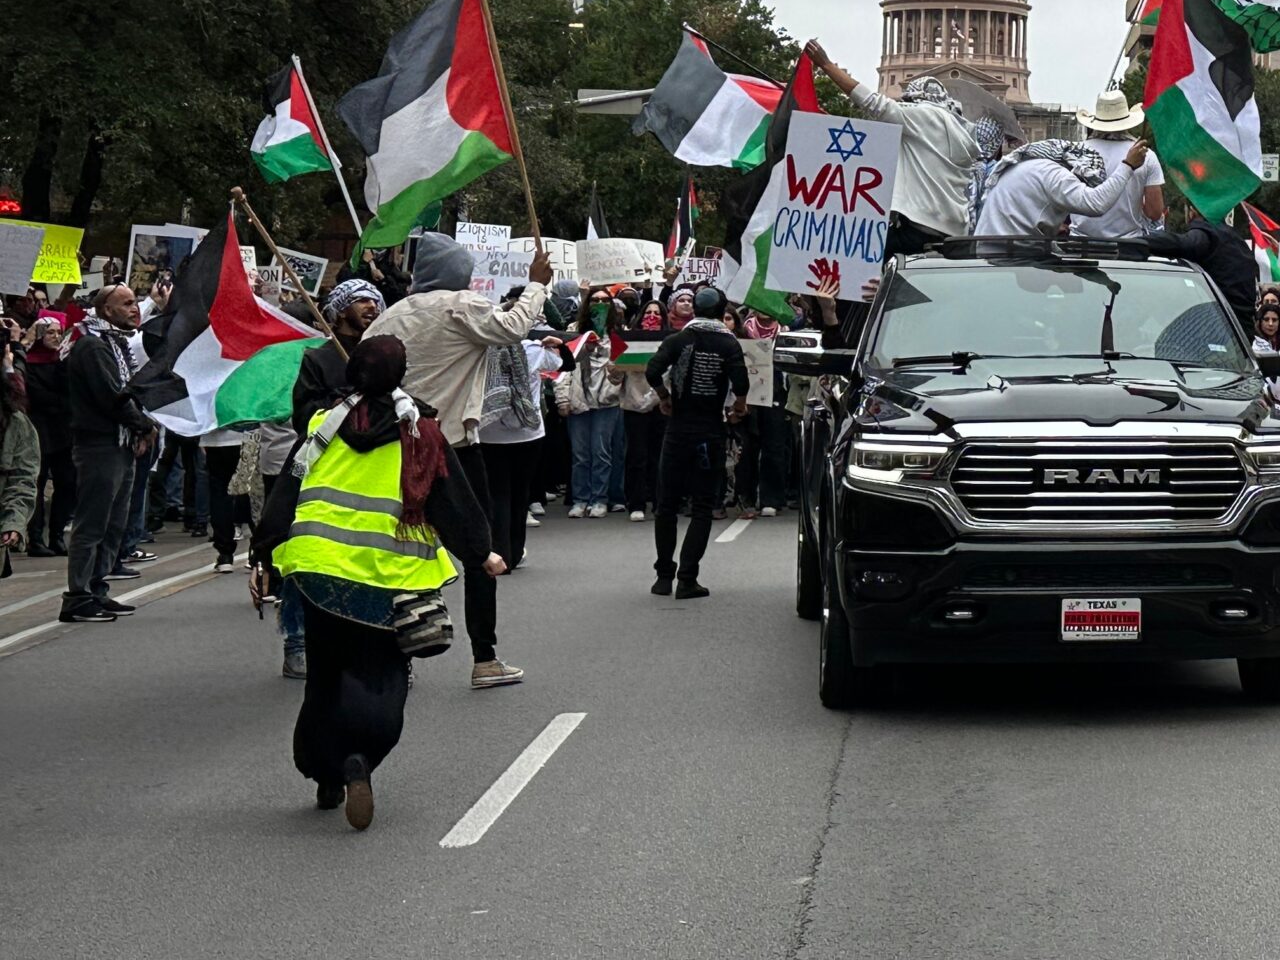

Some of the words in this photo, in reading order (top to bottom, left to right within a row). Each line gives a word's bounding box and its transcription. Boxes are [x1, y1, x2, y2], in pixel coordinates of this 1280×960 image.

[787, 154, 886, 216] WAR
[457, 223, 508, 238] ZIONISM
[773, 207, 887, 263] CRIMINALS
[477, 235, 487, 244] IS
[40, 270, 76, 282] GAZA
[487, 260, 530, 278] CAUS
[1043, 468, 1161, 485] RAM
[1087, 600, 1117, 610] TEXAS
